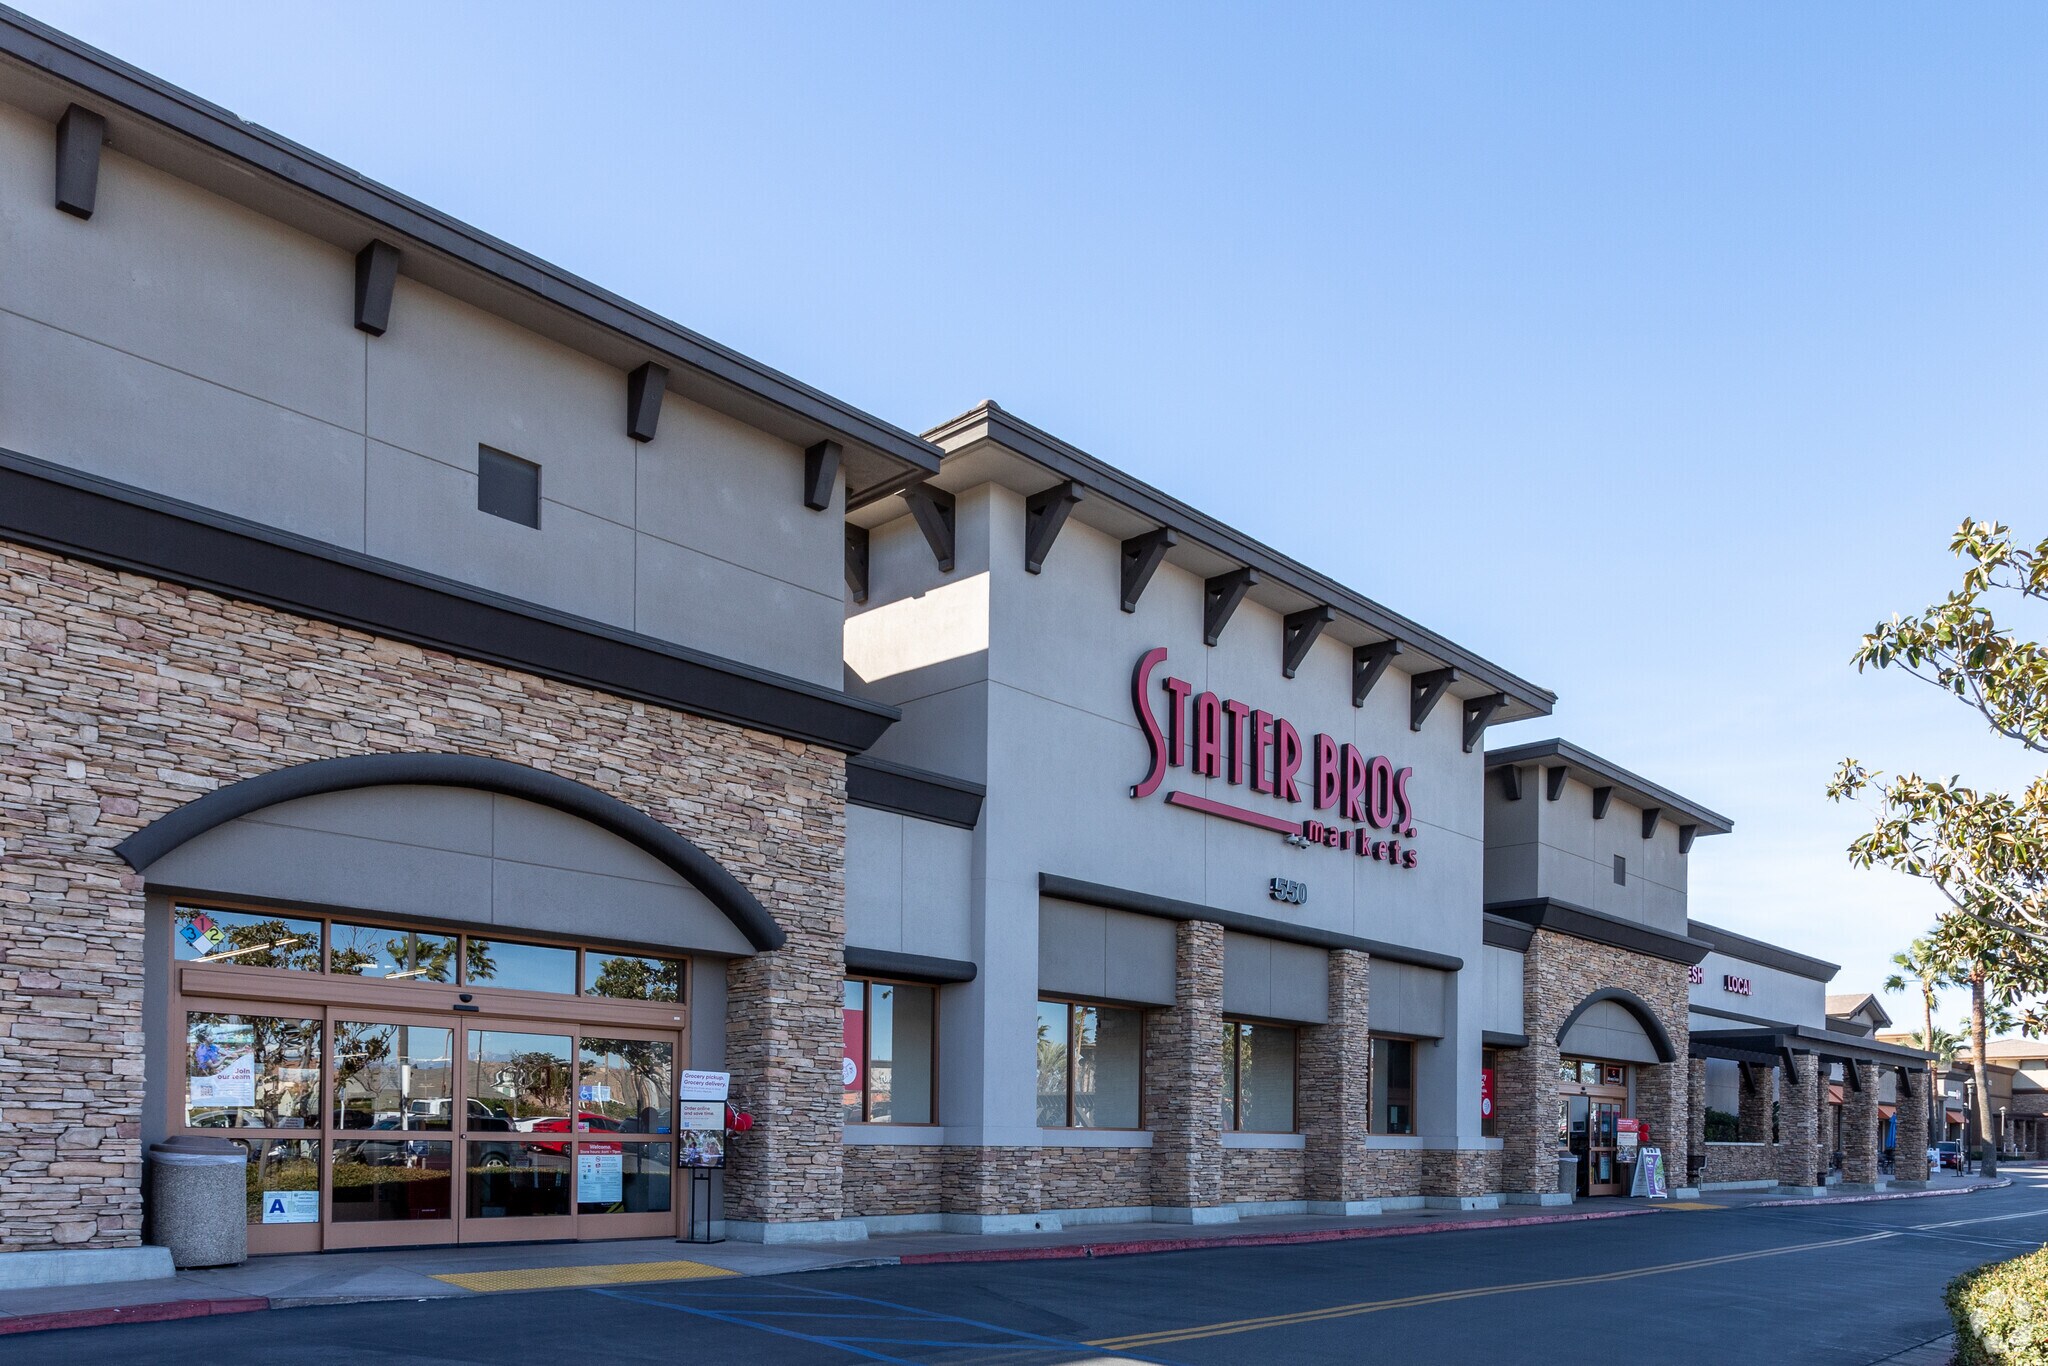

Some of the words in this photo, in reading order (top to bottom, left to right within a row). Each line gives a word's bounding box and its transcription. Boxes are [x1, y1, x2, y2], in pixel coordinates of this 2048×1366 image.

[1130, 647, 1302, 803] STATER
[1303, 819, 1418, 869] markets
[1270, 877, 1308, 905] 550
[199, 917, 206, 931] 1
[186, 927, 197, 940] 3
[209, 928, 220, 941] 2
[1725, 975, 1753, 996] LOCAL
[268, 1198, 286, 1214] A
